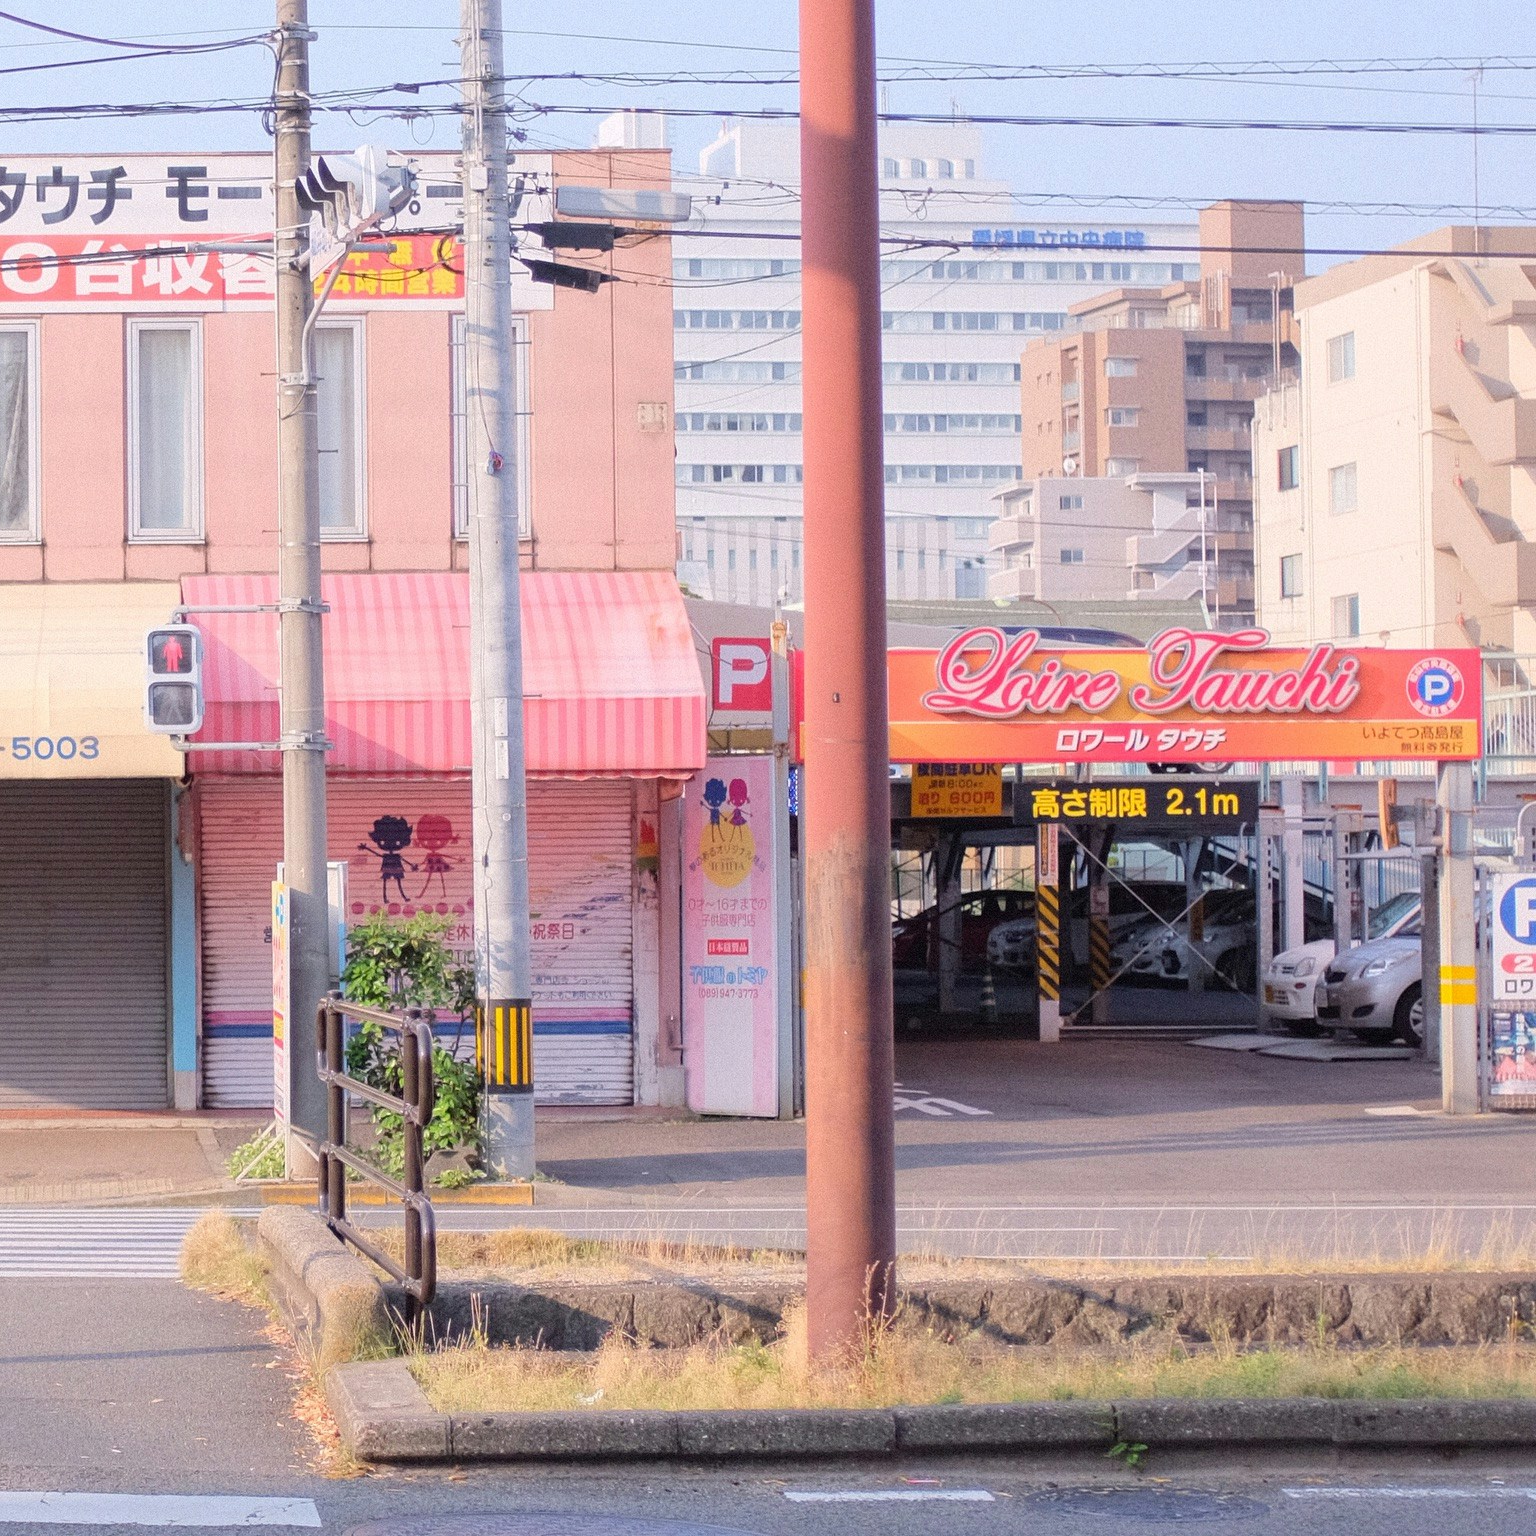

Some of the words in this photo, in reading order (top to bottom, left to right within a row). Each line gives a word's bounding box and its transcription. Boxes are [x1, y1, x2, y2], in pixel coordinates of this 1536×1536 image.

[719, 644, 768, 703] P
[924, 626, 1121, 716] Loire
[1130, 626, 1361, 713] Tauchi
[1425, 675, 1450, 701] P
[1056, 728, 1152, 752] ロワール
[1156, 728, 1228, 752] タウチ
[1031, 788, 1147, 818] 高さ制限
[1166, 788, 1239, 815] 2.1m
